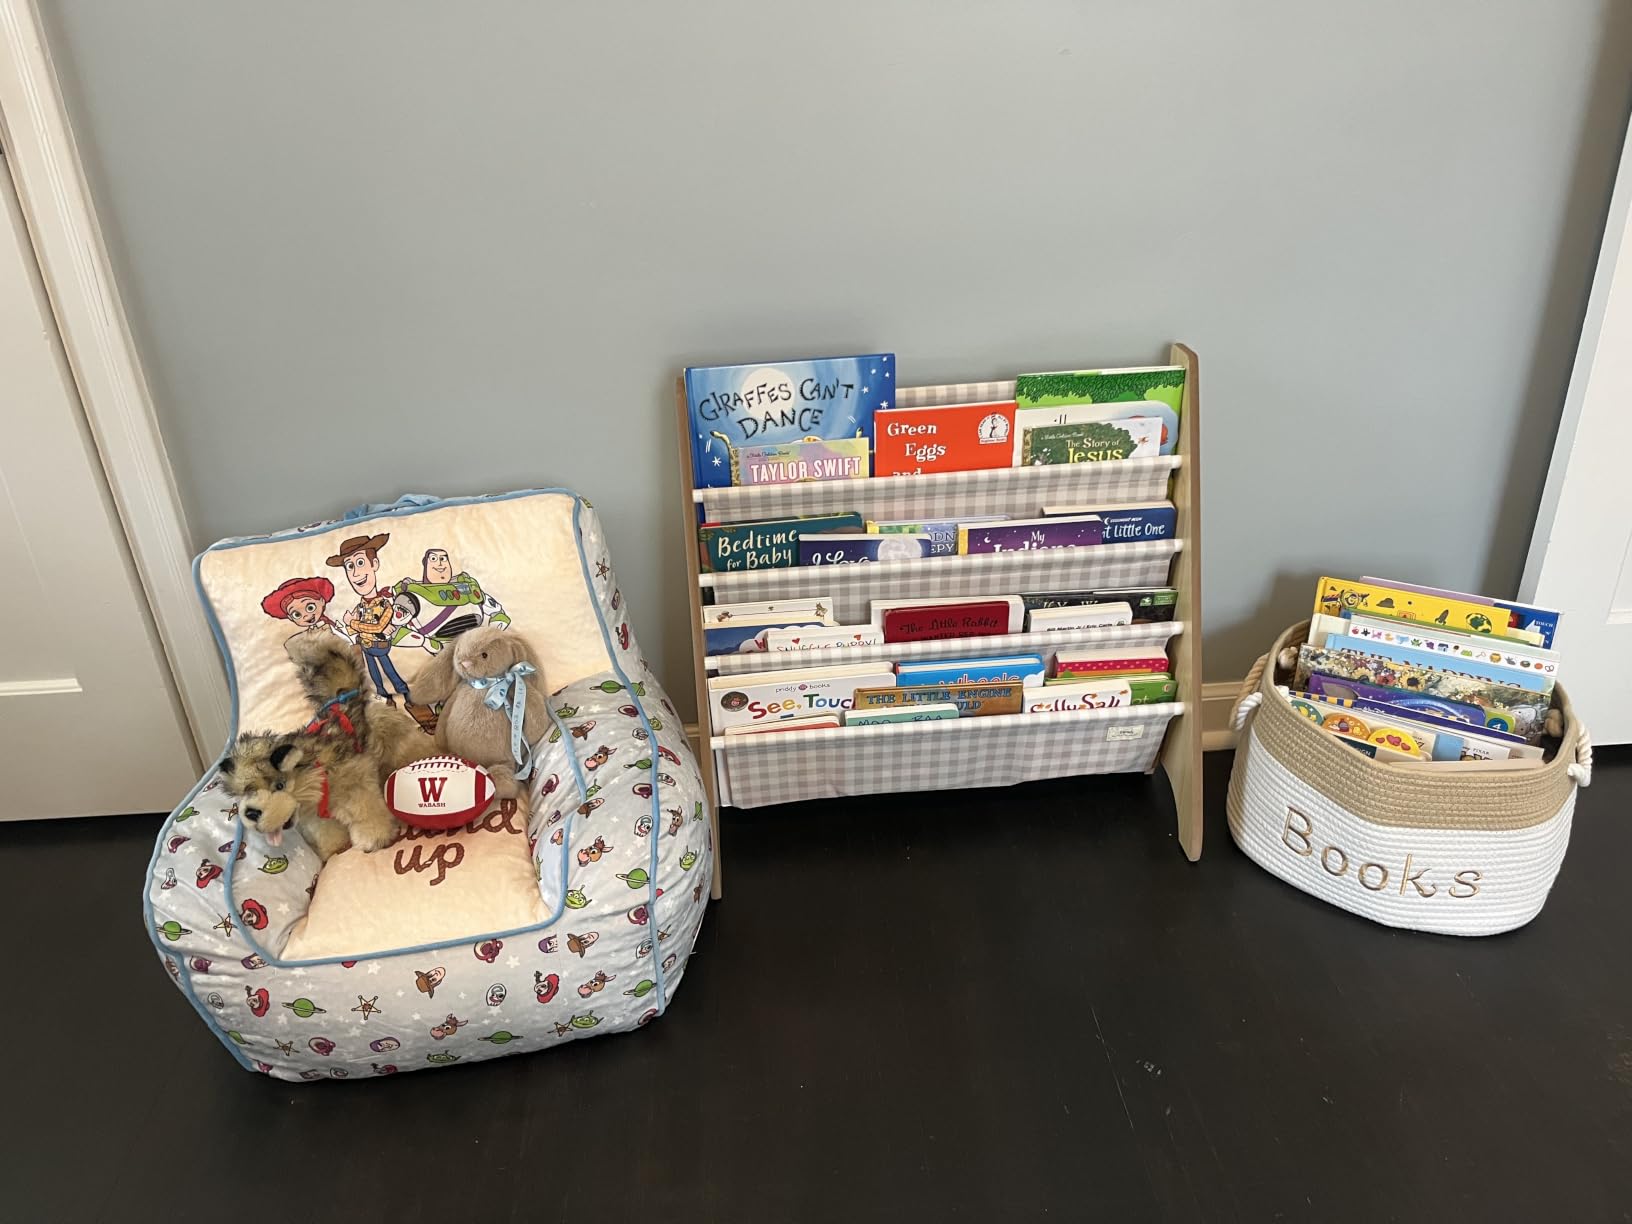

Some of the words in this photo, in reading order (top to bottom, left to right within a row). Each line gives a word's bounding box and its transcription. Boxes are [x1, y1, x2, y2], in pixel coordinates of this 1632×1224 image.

[699, 382, 792, 421] GIRAFFES
[799, 378, 854, 401] CAN'T
[737, 407, 823, 440] DANCE
[887, 422, 937, 437] Green
[905, 443, 946, 462] Eggs
[1066, 439, 1080, 448] The
[1082, 437, 1110, 448] Story
[1068, 448, 1123, 463] Jesus
[750, 461, 808, 483] TAYLOR
[813, 456, 862, 479] SWIFT
[1031, 530, 1045, 544] My
[1145, 523, 1165, 535] One
[718, 528, 798, 558] Bedtime
[727, 558, 741, 571] for
[746, 547, 792, 571] Baby
[867, 695, 897, 705] THE
[901, 691, 951, 703] LITTLE
[957, 688, 1013, 700] ENGINE
[747, 698, 802, 719] See,
[417, 776, 448, 803] W
[1280, 806, 1484, 898] Books
[394, 842, 465, 886] up
